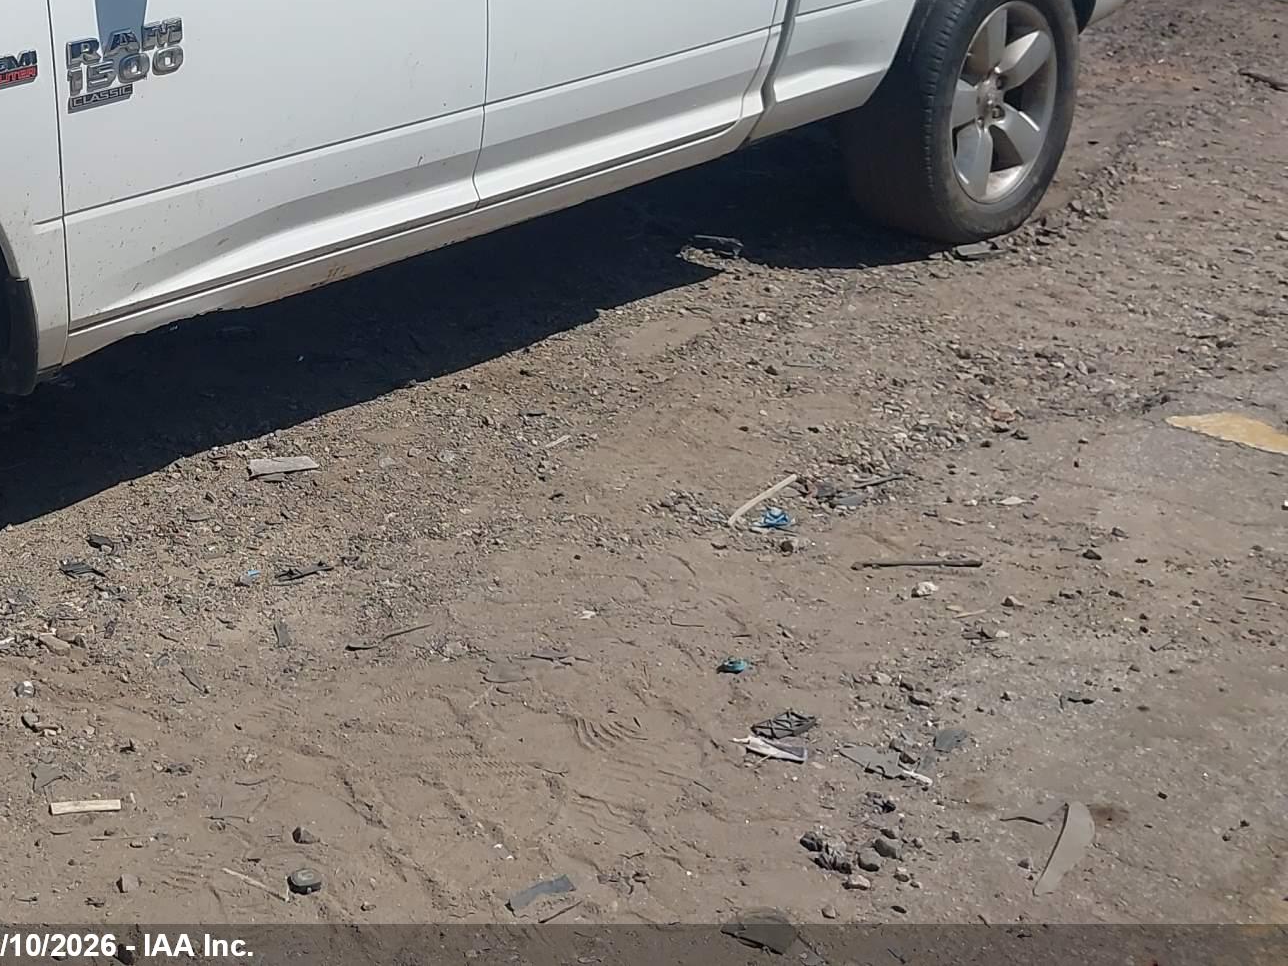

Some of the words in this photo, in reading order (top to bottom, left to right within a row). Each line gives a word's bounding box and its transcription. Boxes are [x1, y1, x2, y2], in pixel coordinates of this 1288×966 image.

[66, 18, 182, 69] RAM
[67, 45, 184, 96] 1500
[71, 85, 133, 110] CLASSIC
